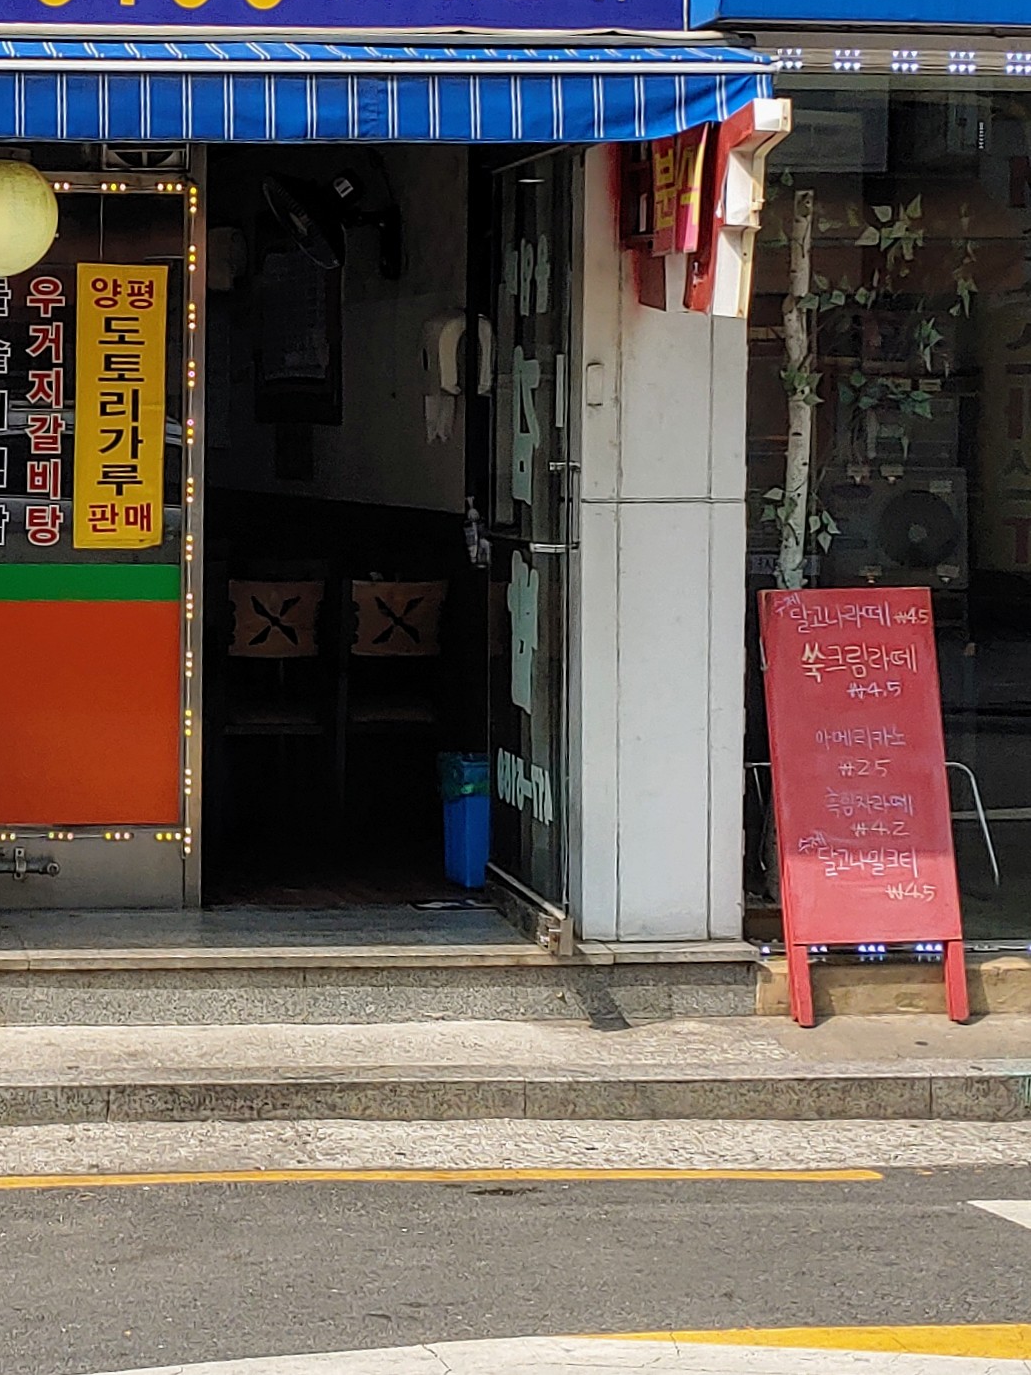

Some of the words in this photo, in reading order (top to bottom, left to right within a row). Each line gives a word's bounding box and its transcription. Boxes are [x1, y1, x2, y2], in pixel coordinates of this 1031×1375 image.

[90, 277, 155, 309] 양평
[25, 276, 65, 546] 우거지갈비탕
[96, 316, 145, 496] 도토리가루
[86, 502, 153, 533] 판매
[801, 641, 918, 683] 쑥크림라떼
[815, 725, 907, 751] 아메리카노
